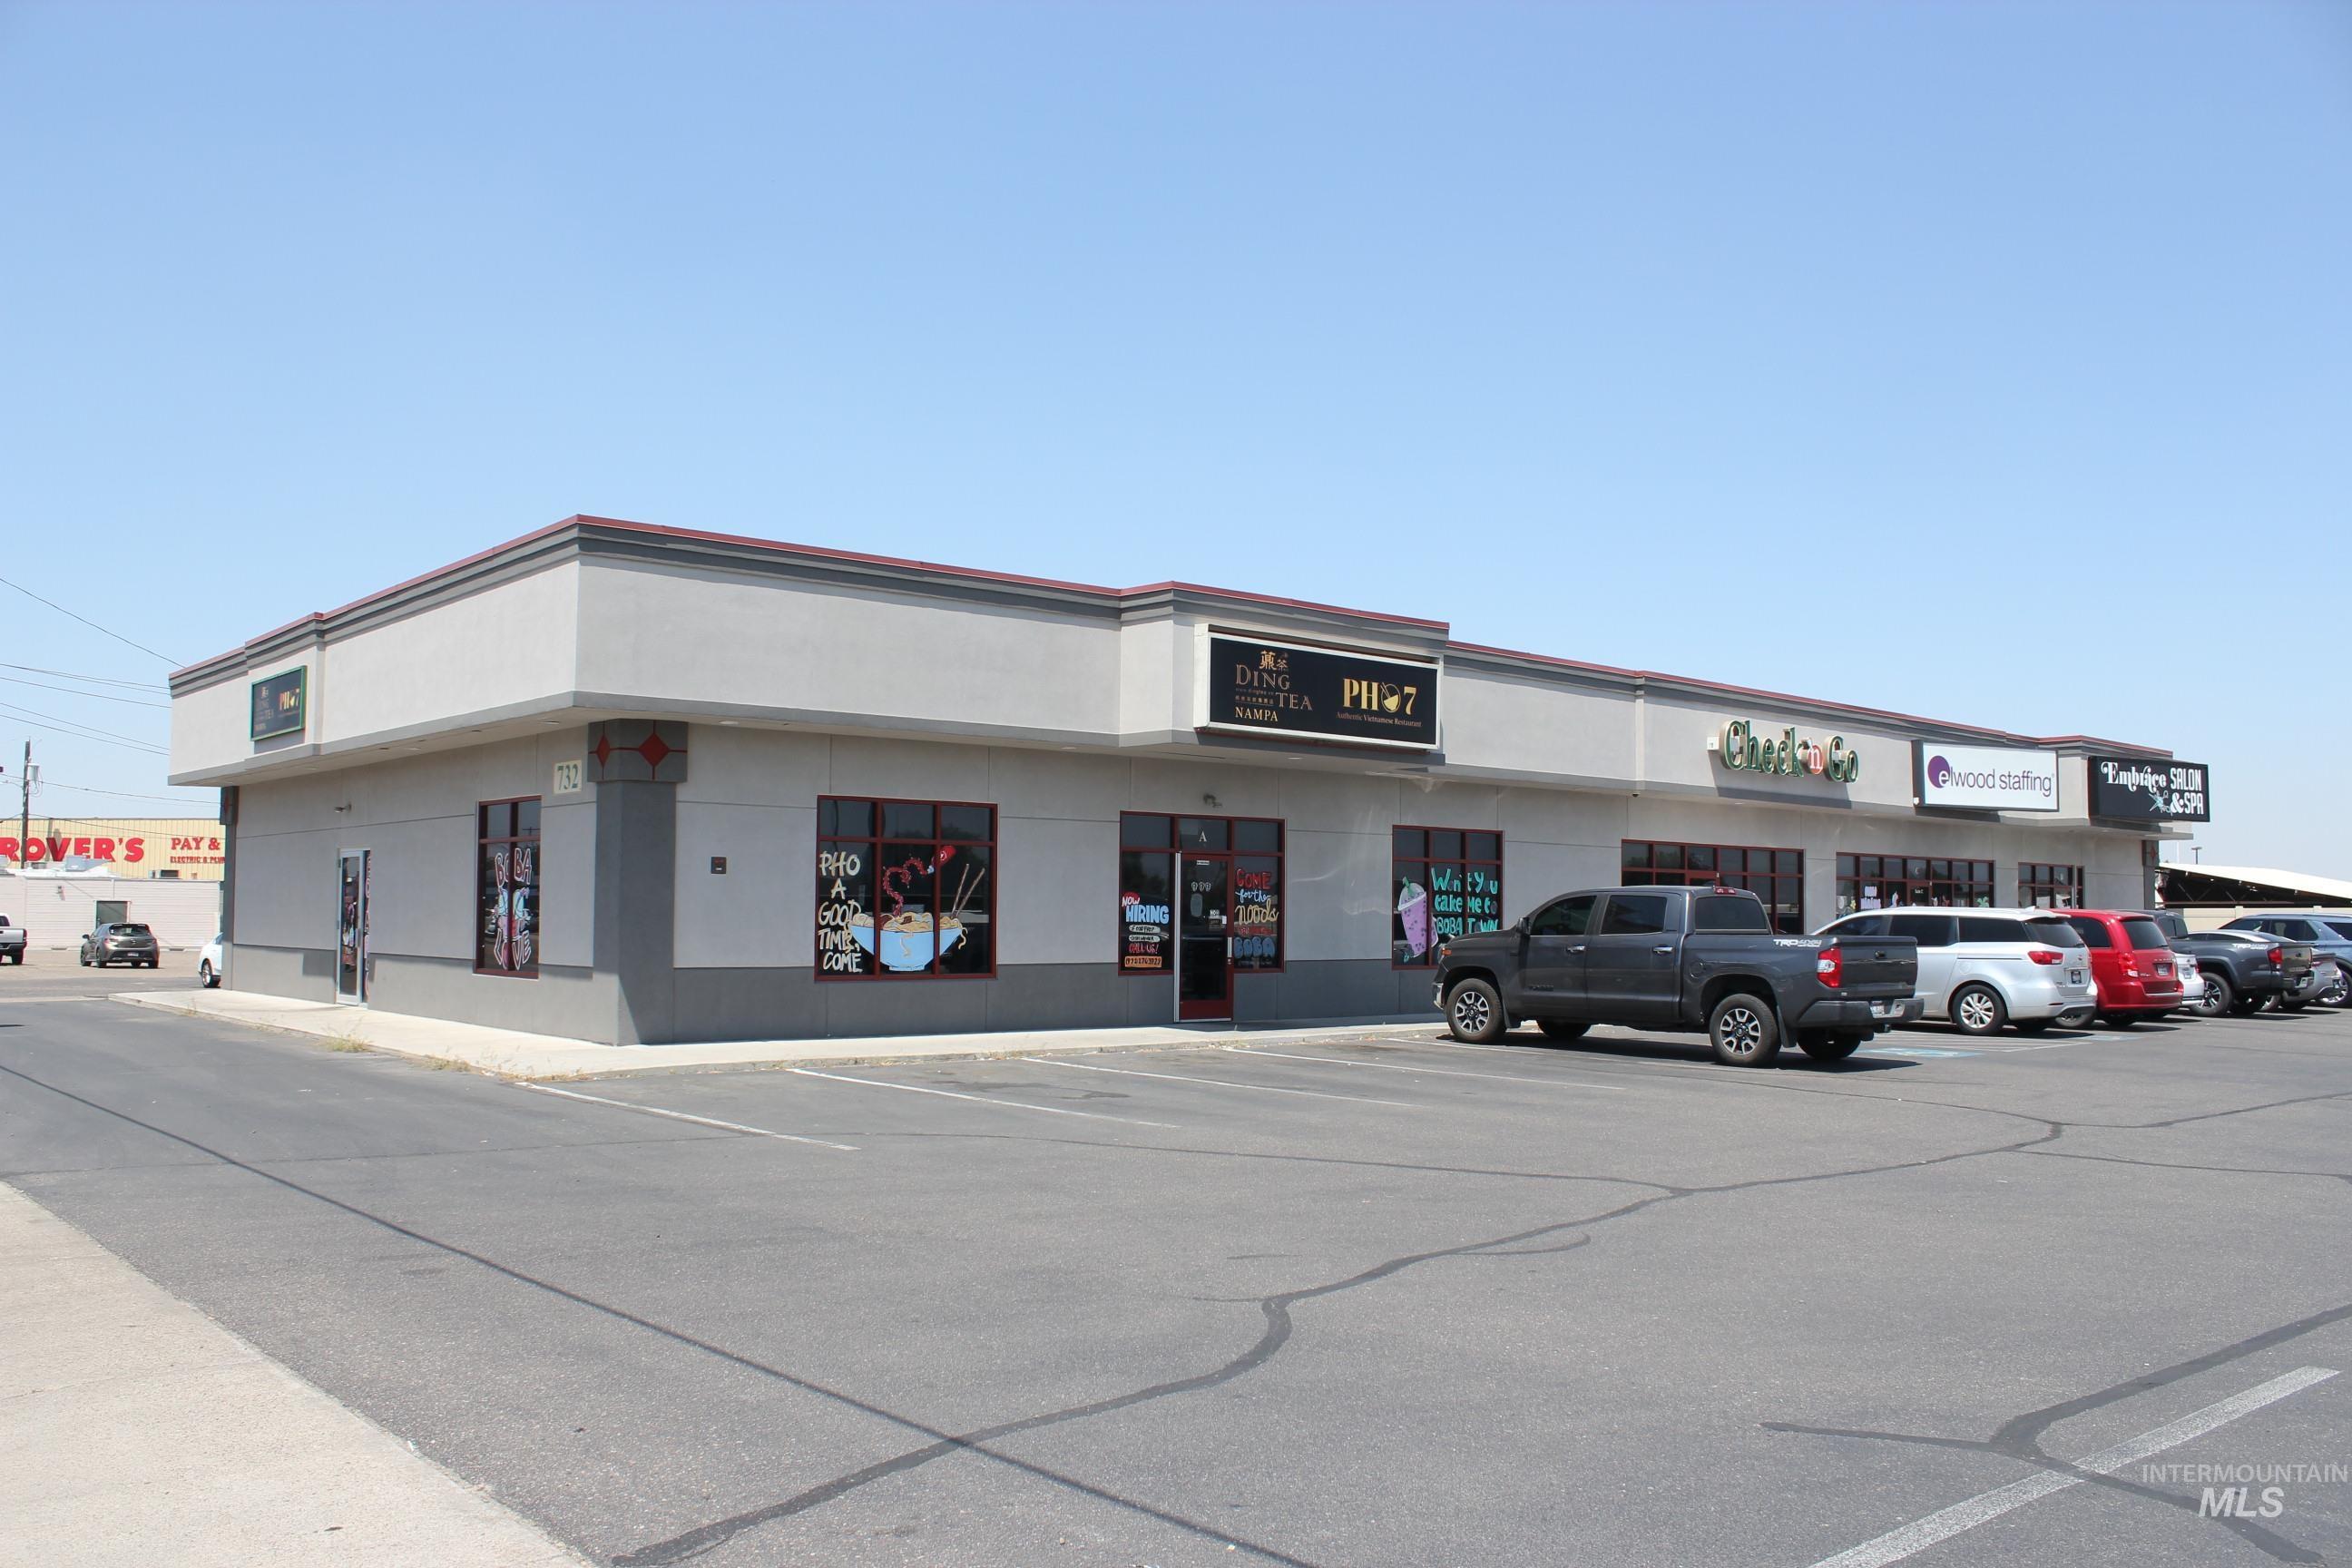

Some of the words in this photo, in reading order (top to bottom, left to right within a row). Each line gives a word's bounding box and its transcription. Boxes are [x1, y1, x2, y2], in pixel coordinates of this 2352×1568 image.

[1235, 663, 1290, 691] DING
[1275, 692, 1313, 711] TEA
[1235, 707, 1279, 722] NAMPA
[1336, 710, 1363, 721] Authentic
[1363, 713, 1395, 725] Vietnamese
[1394, 718, 1422, 728] Restaurant
[1725, 720, 1804, 778] Check
[1828, 735, 1859, 783] Go
[557, 763, 579, 791] 732
[1938, 766, 1995, 789] elwood
[1999, 769, 2053, 798] staffing
[2101, 761, 2167, 793] Embrace
[2170, 767, 2202, 791] SALON
[2170, 791, 2184, 814] &
[2183, 792, 2204, 815] SPA
[171, 837, 204, 850] PAY
[208, 837, 220, 850] &
[1199, 830, 1208, 842] A
[818, 851, 861, 877] PHO
[830, 877, 848, 900] A
[1237, 868, 1271, 889] COME
[1122, 896, 1141, 907] NOW
[1252, 889, 1271, 903] the
[1435, 895, 1464, 914] take
[1484, 895, 1498, 915] to
[818, 899, 862, 926] GOOD
[1125, 904, 1170, 925] HIRING
[1436, 916, 1464, 936] BOBA
[823, 951, 863, 973] COME
